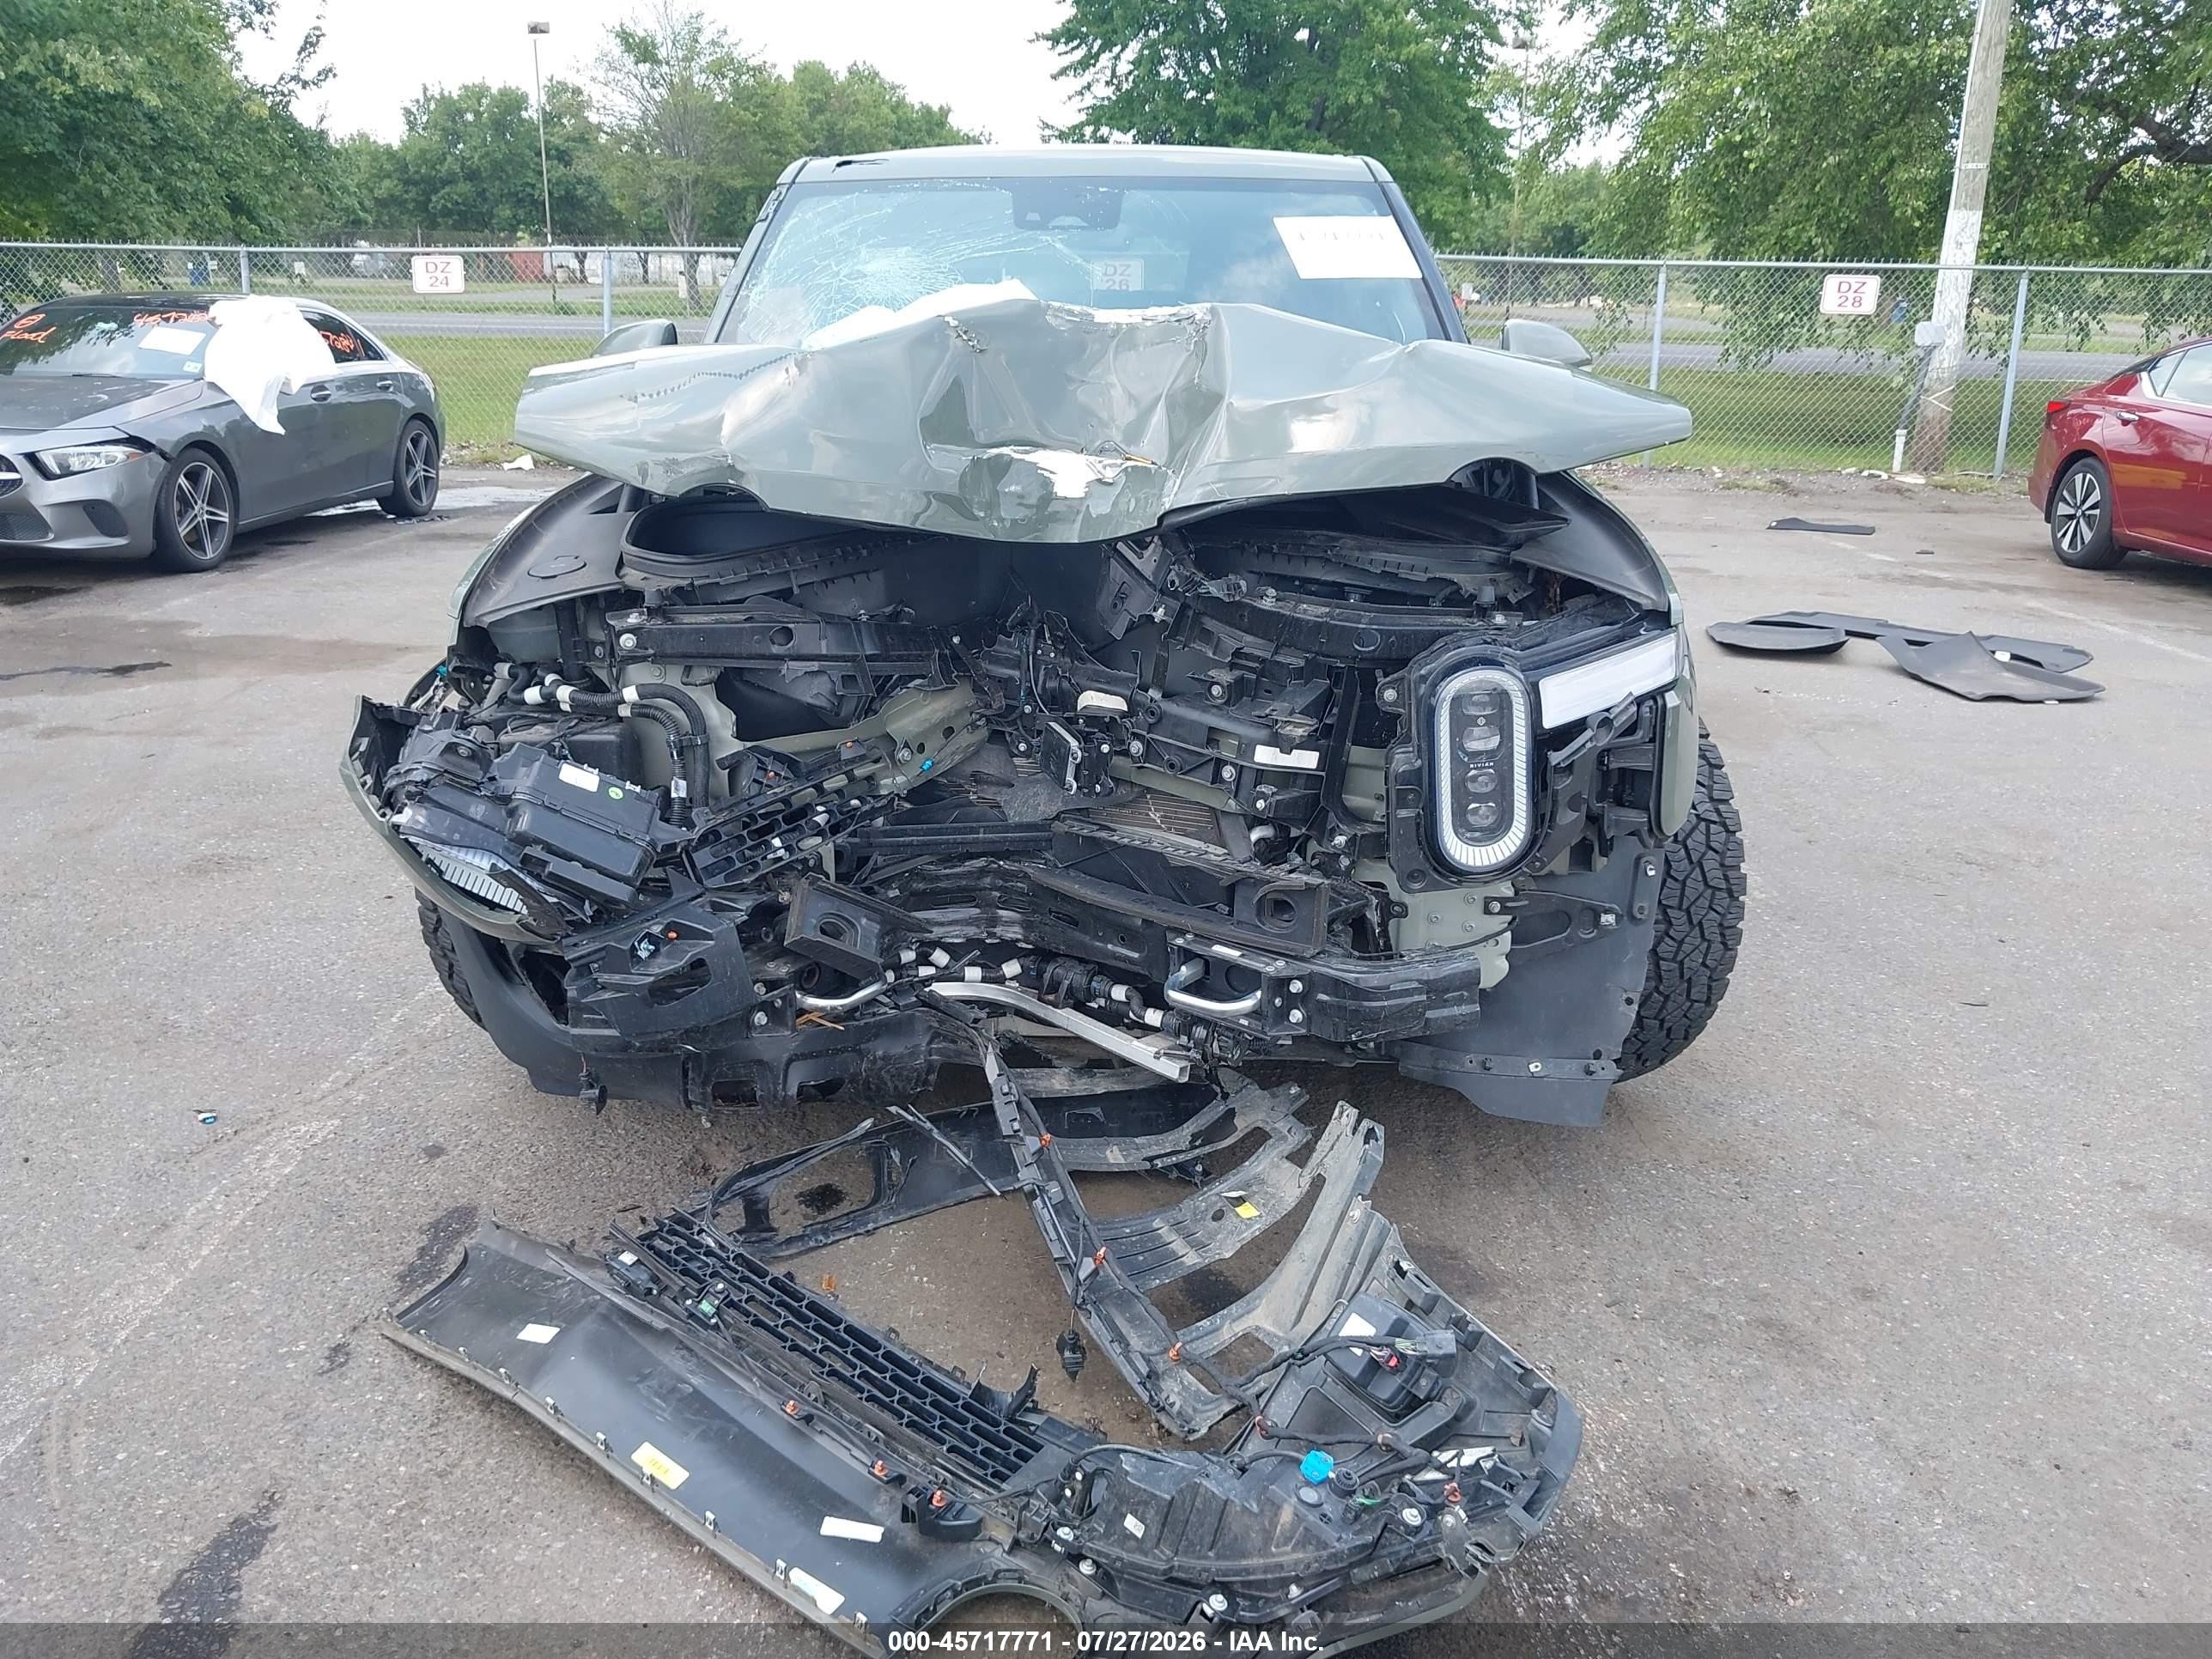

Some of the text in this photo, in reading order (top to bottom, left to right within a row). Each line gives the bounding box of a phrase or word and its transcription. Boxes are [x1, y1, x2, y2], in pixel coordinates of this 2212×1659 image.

[425, 261, 452, 274] DZ
[1104, 264, 1132, 276] DZ
[428, 275, 449, 288] 24
[1105, 278, 1130, 290] 26
[1837, 281, 1868, 294] DZ
[1837, 295, 1863, 308] 28
